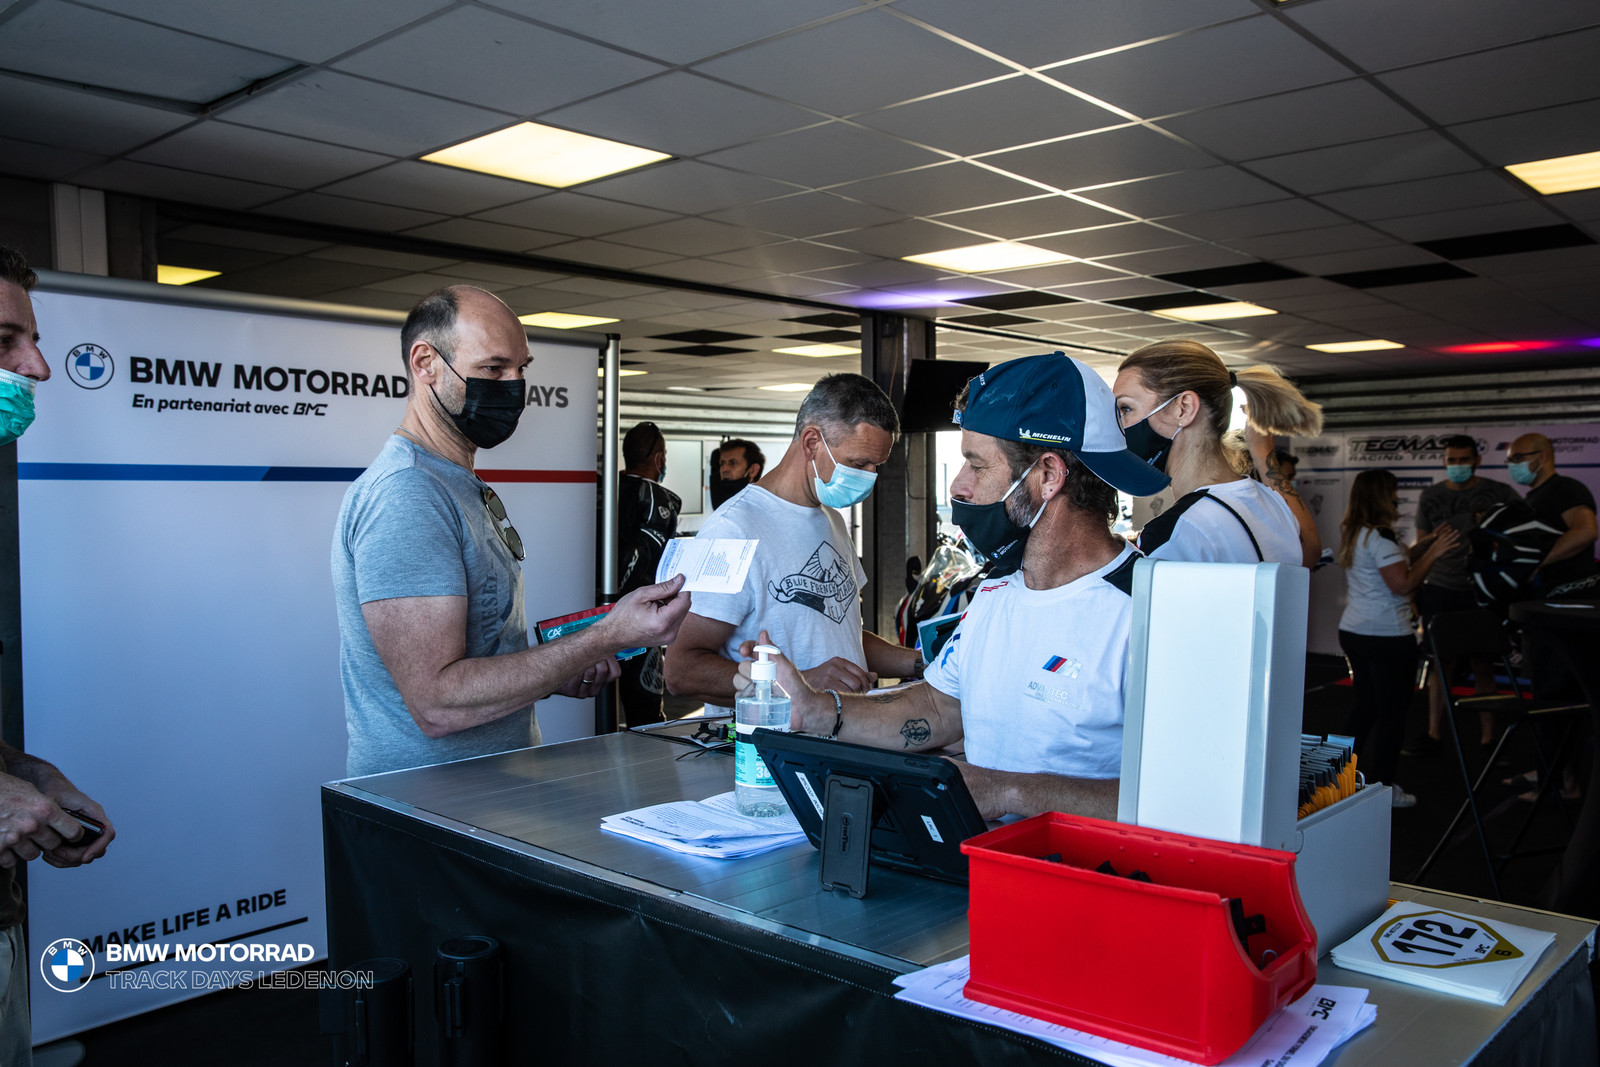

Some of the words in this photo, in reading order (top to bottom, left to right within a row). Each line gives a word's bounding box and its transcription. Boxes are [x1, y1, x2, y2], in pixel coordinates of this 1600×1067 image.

[129, 356, 222, 388] BMW
[233, 364, 409, 398] MOTORRAD
[526, 385, 569, 409] AYS
[132, 394, 154, 409] En
[157, 397, 251, 413] partenariat
[254, 403, 289, 415] avec
[293, 402, 328, 416] BMC
[1031, 431, 1072, 443] MICHELIN
[785, 578, 808, 590] BLUE
[82, 921, 156, 955] MAKE
[162, 907, 211, 937] LIFE
[215, 903, 232, 922] A
[236, 888, 287, 918] RIDE
[1391, 919, 1478, 957] 172
[1311, 997, 1336, 1020] BMC
